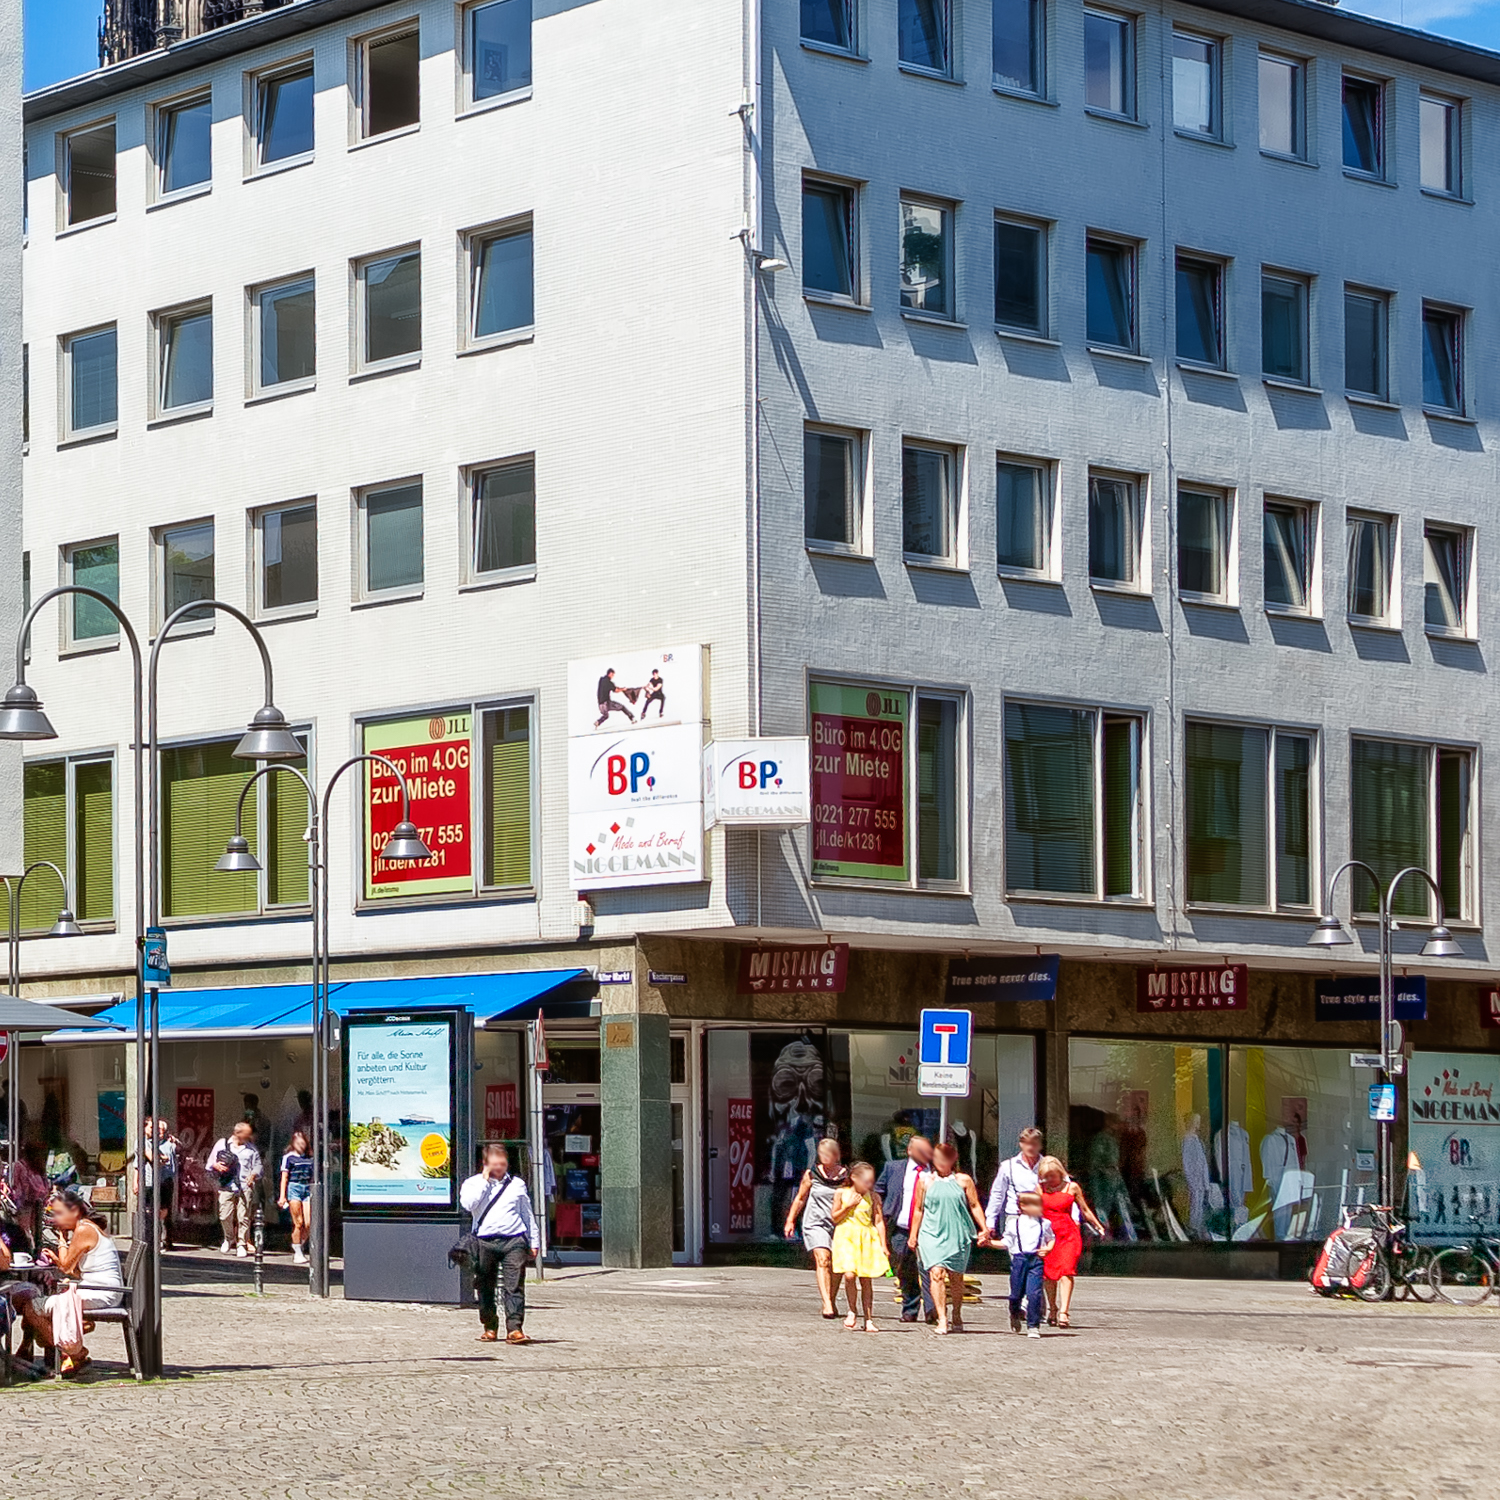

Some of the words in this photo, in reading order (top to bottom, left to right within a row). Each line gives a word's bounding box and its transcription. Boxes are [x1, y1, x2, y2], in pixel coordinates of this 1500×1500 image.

[881, 697, 903, 716] JLL
[446, 717, 470, 735] JLL
[814, 721, 847, 746] Büro
[850, 725, 866, 749] im
[868, 727, 902, 752] 4.OG
[411, 752, 429, 774] im
[431, 745, 470, 772] 4.OG
[814, 754, 842, 774] zur
[845, 752, 890, 779] Miete
[371, 784, 402, 805] zur
[406, 775, 456, 801] Miete
[814, 803, 844, 824] 0221
[848, 808, 870, 827] 277
[874, 810, 897, 830] 555
[437, 824, 464, 845] 555
[815, 828, 883, 852] jll.de/k1281
[573, 849, 697, 874] NIGGEMANN
[749, 949, 837, 978] MUSTANG
[769, 977, 834, 989] JEANS
[951, 975, 972, 986] True
[974, 974, 997, 986] style
[999, 974, 1026, 984] never
[1028, 972, 1052, 982] dies.
[1148, 969, 1235, 997] MUSTANG
[1170, 996, 1235, 1008] JEANS
[356, 1050, 370, 1061] Für
[371, 1050, 386, 1061] alle,
[387, 1050, 399, 1060] die
[400, 1049, 424, 1060] Sonne
[356, 1063, 387, 1073] anbeten
[388, 1062, 403, 1072] und
[404, 1062, 428, 1072] Kultur
[356, 1076, 396, 1087] vergöttern.
[180, 1093, 212, 1108] SALE
[486, 1090, 517, 1120] SALE!
[729, 1104, 753, 1120] SALE
[730, 1214, 752, 1229] SALE
